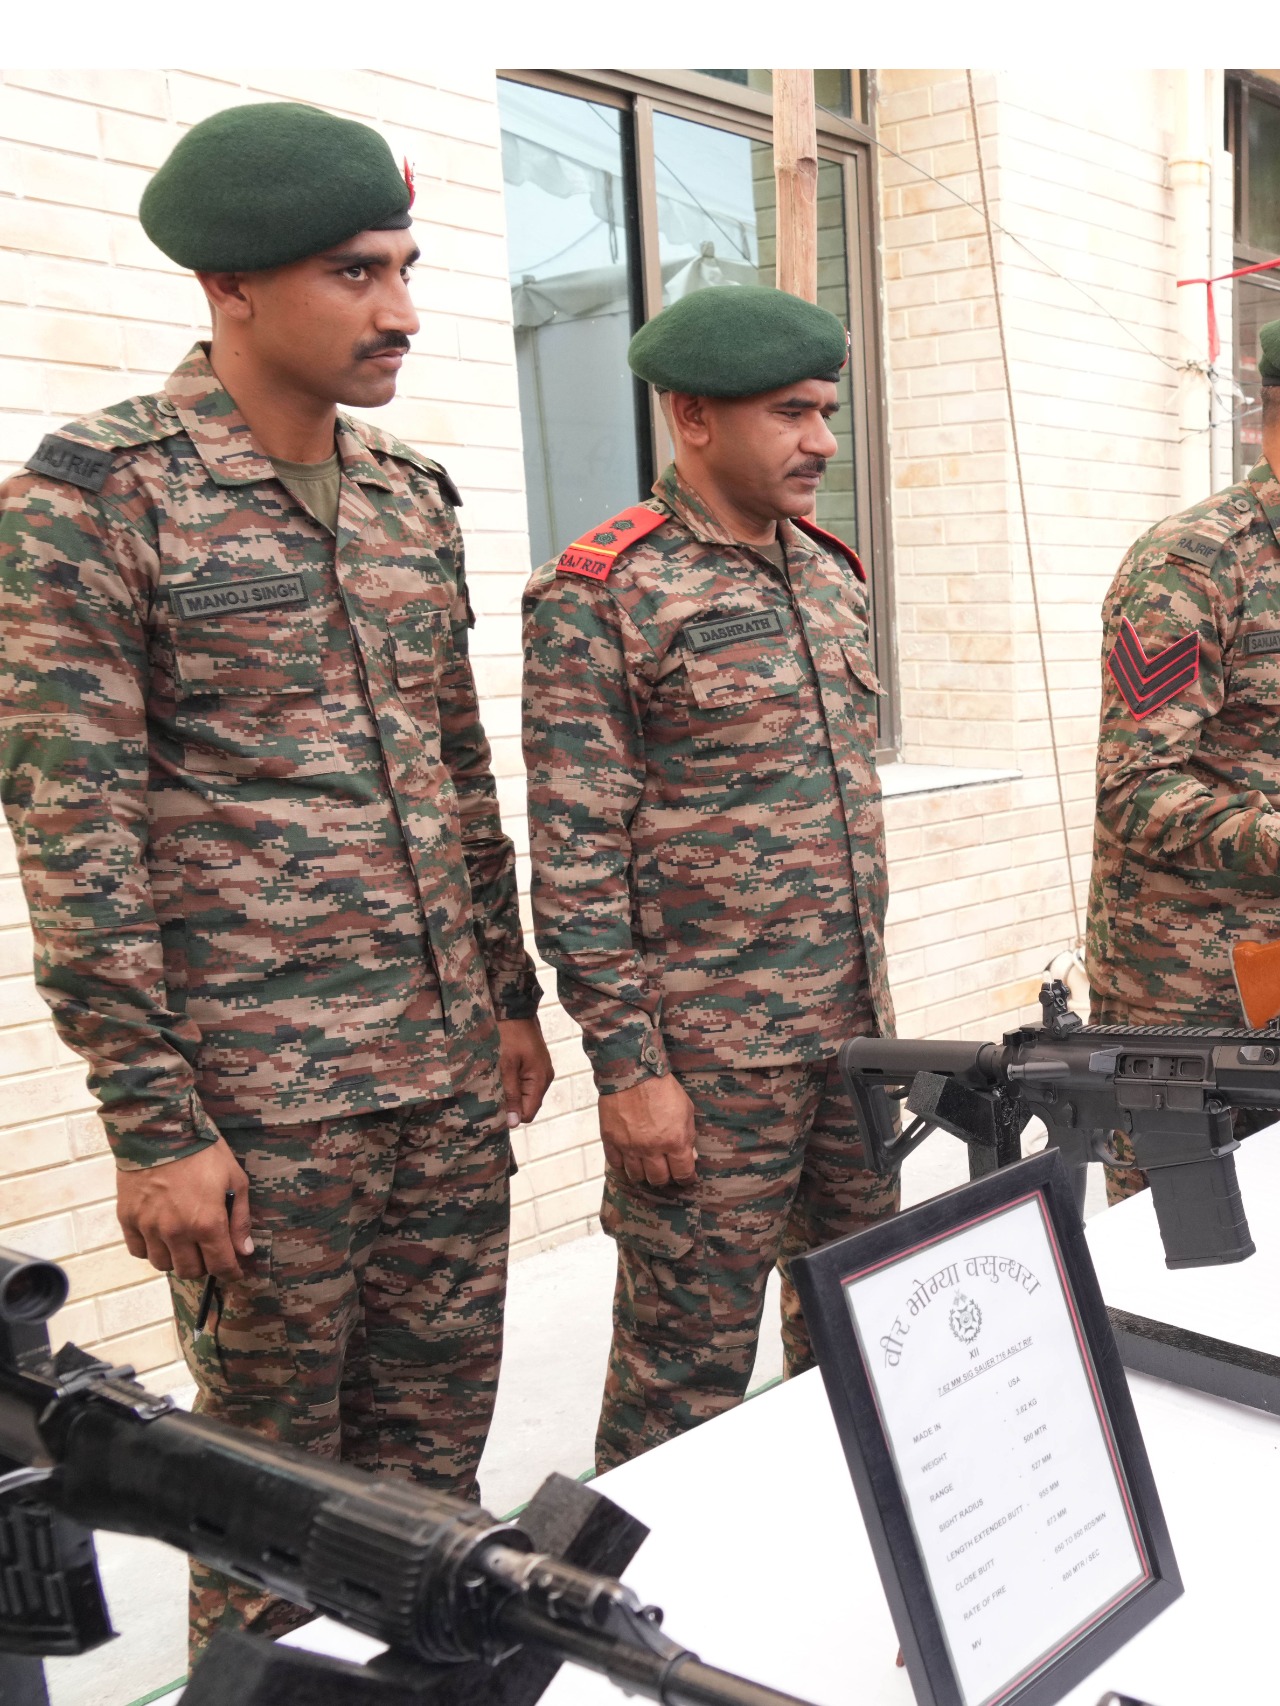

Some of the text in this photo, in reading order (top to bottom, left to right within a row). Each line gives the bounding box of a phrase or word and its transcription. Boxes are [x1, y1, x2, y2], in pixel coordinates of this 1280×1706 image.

[66, 456, 103, 478] RIF
[187, 582, 300, 612] MANOJ SINGH
[558, 554, 607, 575] RAJ RIF
[700, 618, 771, 642] DASHRATH
[879, 1255, 1042, 1369] वीर भोग्या वसुन्धरा
[951, 1375, 962, 1388] MM
[962, 1369, 974, 1382] SIG
[973, 1356, 995, 1376] SAUER
[1006, 1342, 1023, 1358] ASLT
[1022, 1336, 1034, 1349] RIF
[968, 1347, 980, 1360] XII
[912, 1376, 1021, 1445] MADE IN USA
[920, 1452, 948, 1474] WEIGHT
[1028, 1397, 1038, 1409] KG
[929, 1423, 1048, 1503] RANGE 500 MTR
[938, 1452, 1053, 1532] SIGHT RADIUS 527 MM
[946, 1540, 974, 1563] LENGTH
[973, 1516, 1008, 1543] EXTENDED
[1007, 1504, 1024, 1521] BUTT
[1049, 1480, 1060, 1492] MM
[955, 1570, 978, 1592] CLOSE
[977, 1558, 996, 1576] BUTT
[1056, 1507, 1068, 1519] MM
[963, 1602, 982, 1621] RATE
[981, 1596, 991, 1608] OF
[991, 1584, 1007, 1601] FIRE
[1064, 1535, 1074, 1547] TO
[971, 1637, 983, 1651] MV
[1072, 1559, 1086, 1574] MTR
[1088, 1548, 1101, 1562] SEC
